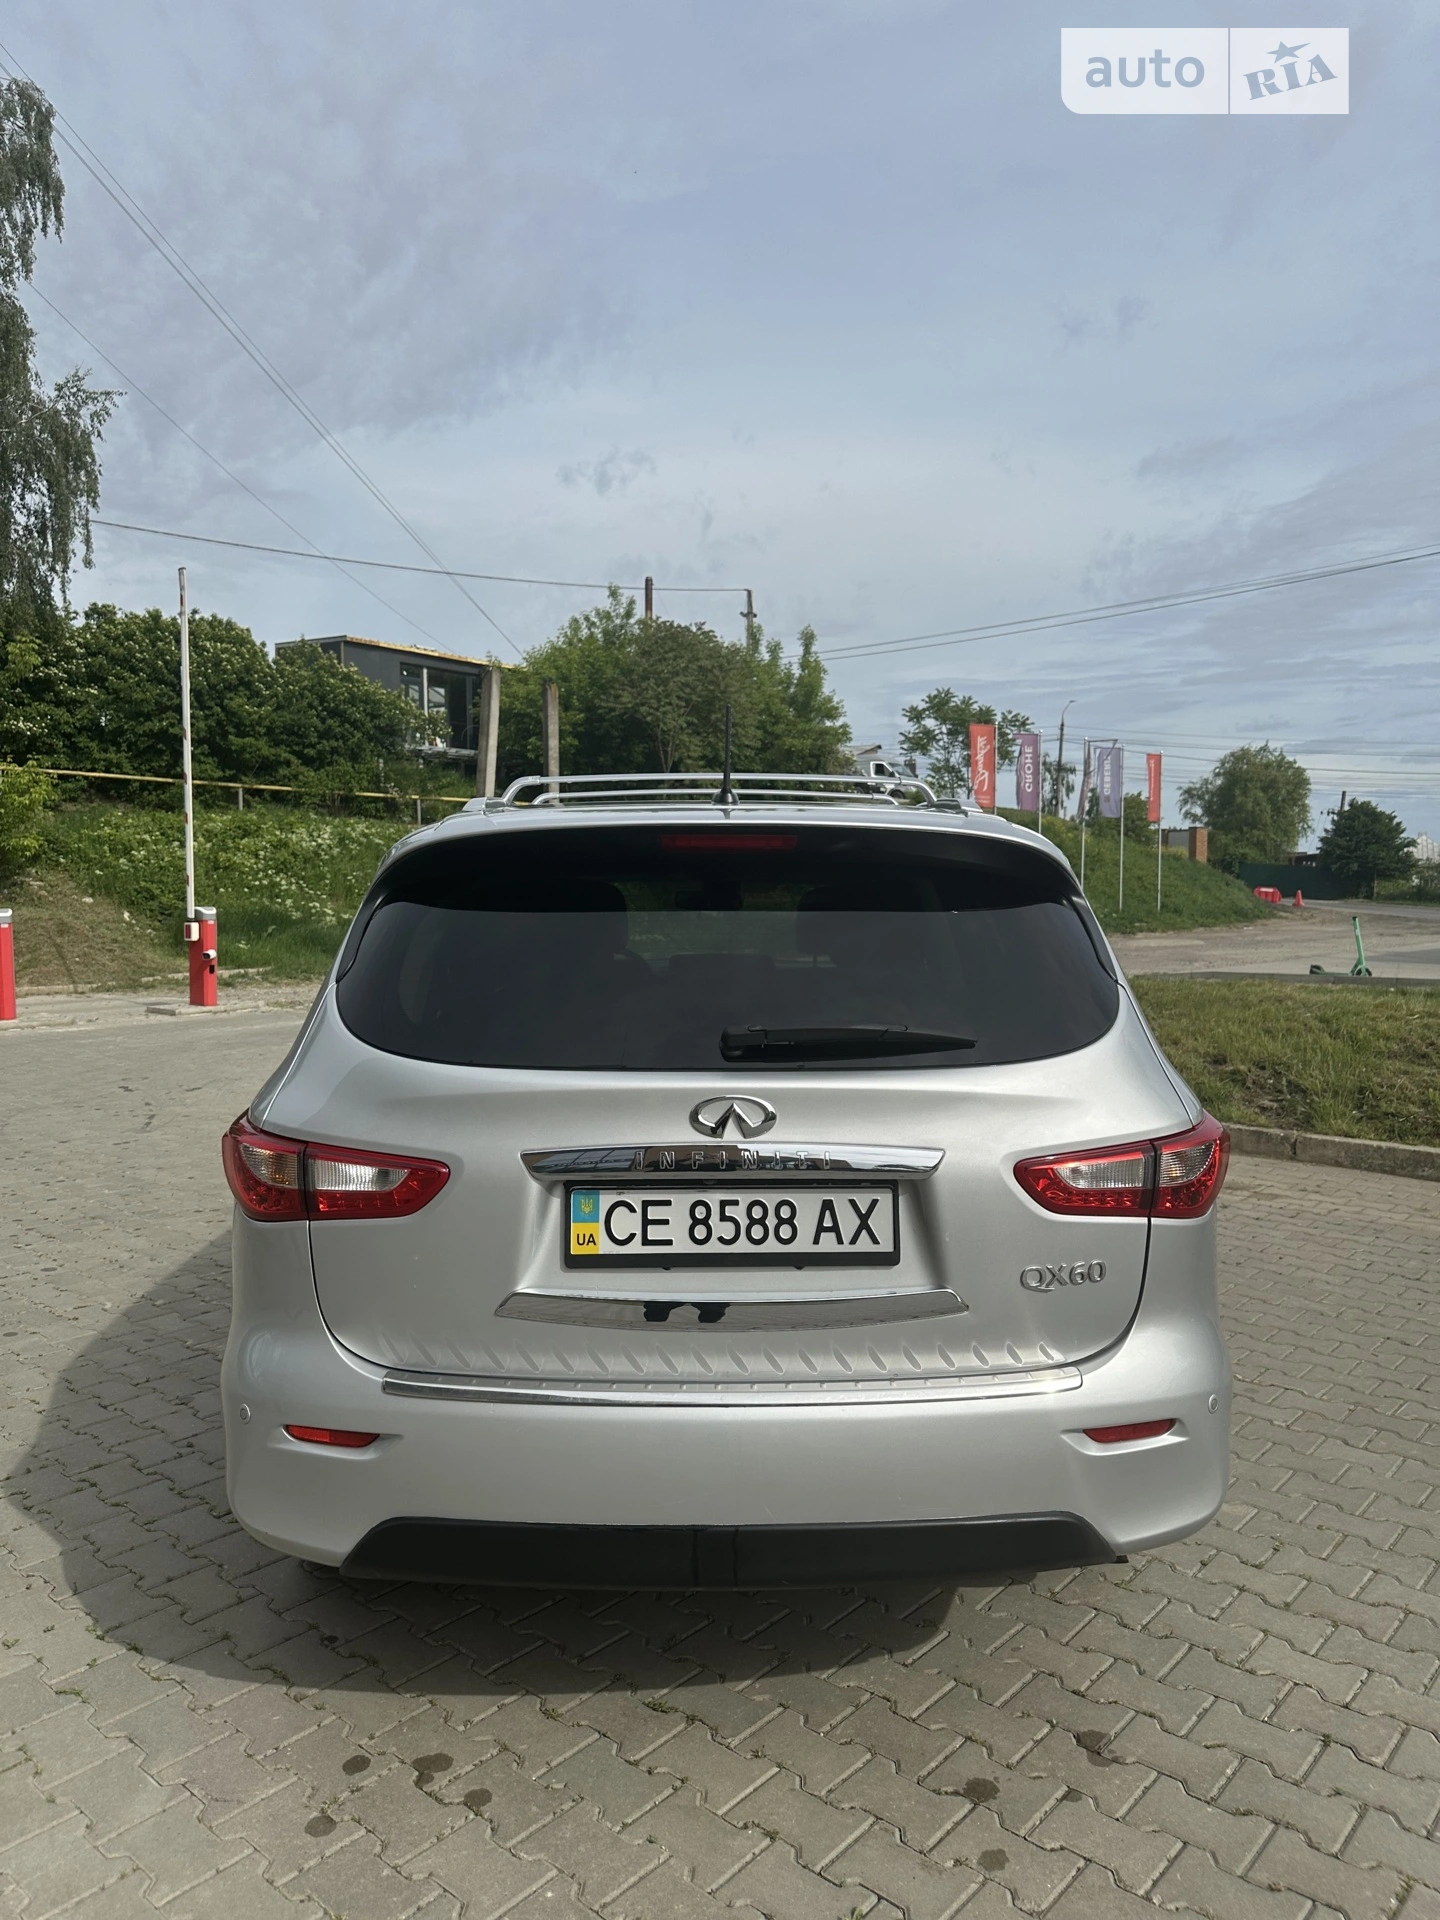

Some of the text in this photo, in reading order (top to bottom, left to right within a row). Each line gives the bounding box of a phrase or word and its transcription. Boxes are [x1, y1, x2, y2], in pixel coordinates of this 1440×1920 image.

[635, 1151, 831, 1170] INFINITI
[604, 1198, 881, 1246] CE 8588 AX
[576, 1233, 597, 1246] UA
[1020, 1259, 1107, 1293] QX60
